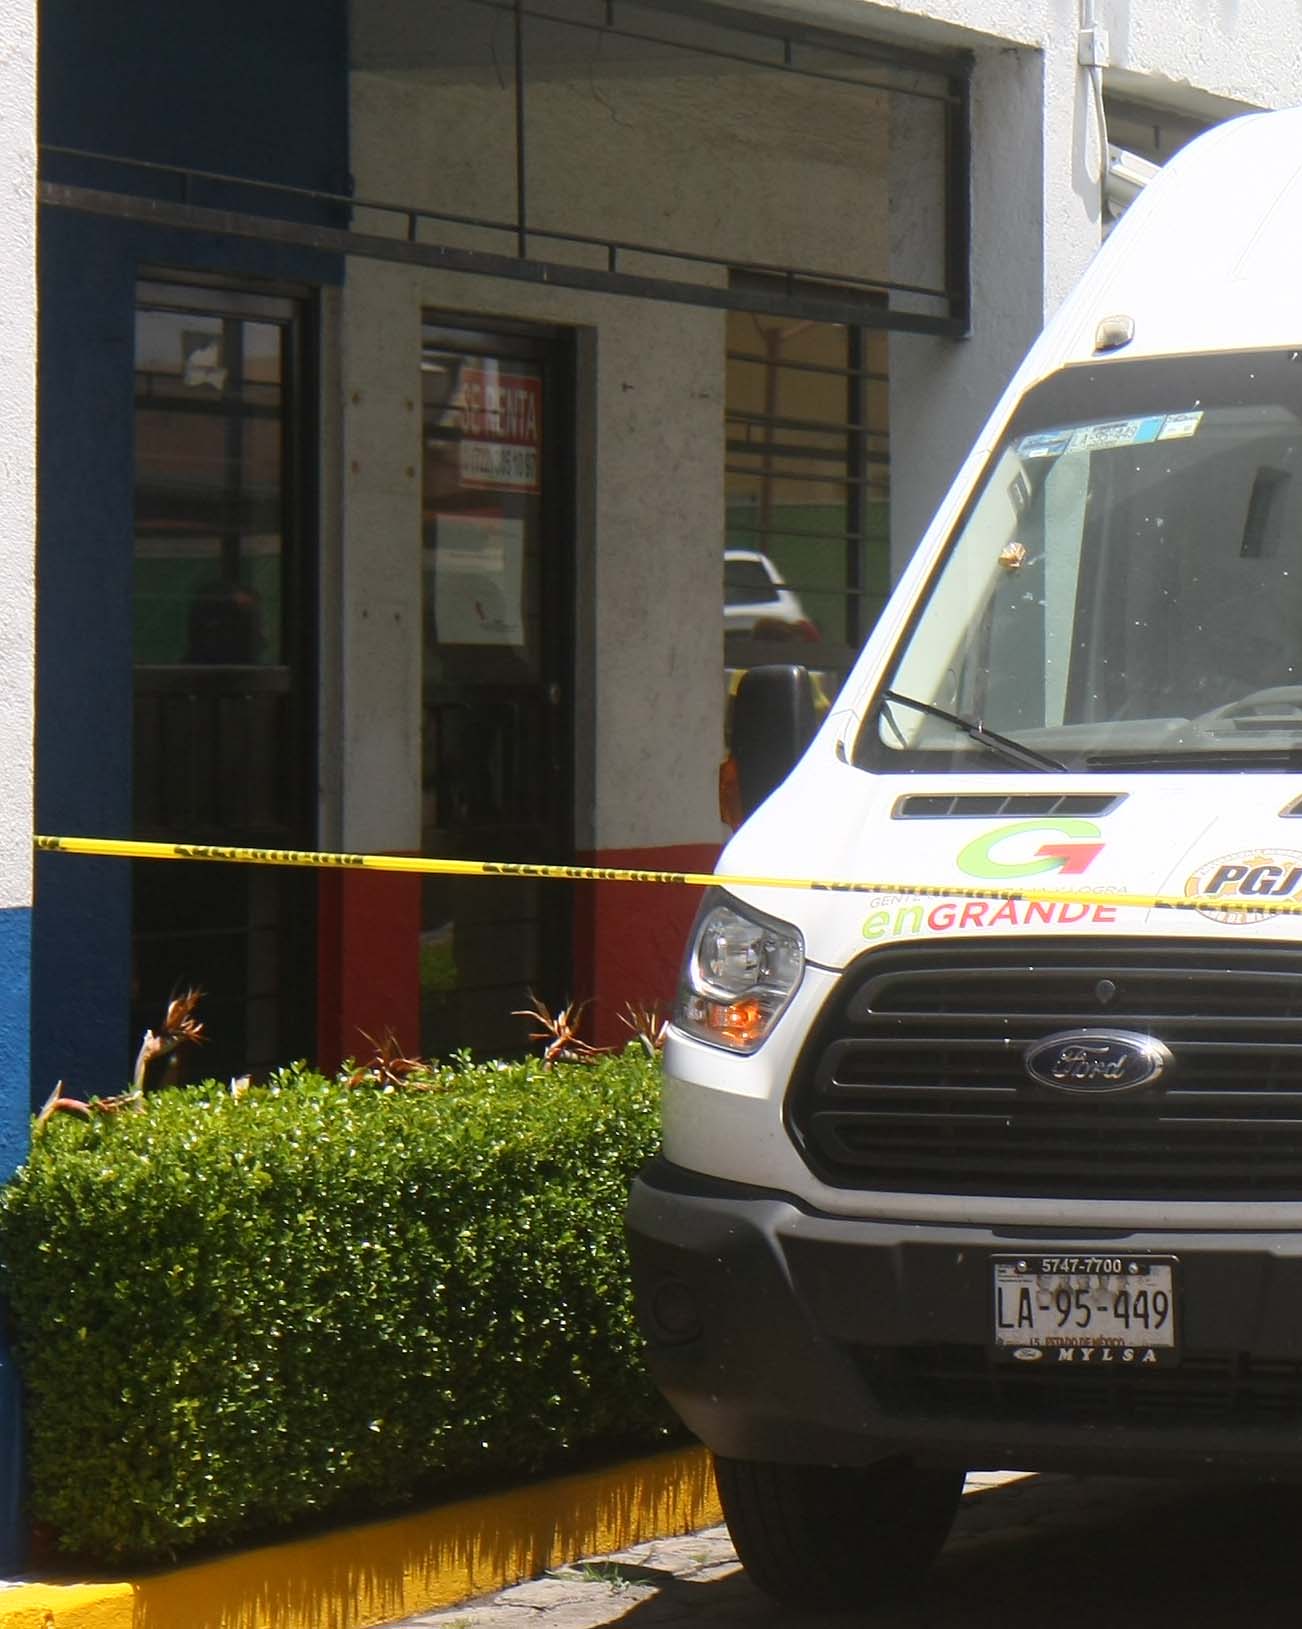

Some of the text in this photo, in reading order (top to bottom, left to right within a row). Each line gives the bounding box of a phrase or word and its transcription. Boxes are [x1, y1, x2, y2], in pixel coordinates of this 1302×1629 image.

[861, 899, 1118, 941] enGRANDE
[1051, 1044, 1128, 1079] Ford
[1041, 1258, 1122, 1273] 5747-7700
[997, 1287, 1169, 1329] LA-95-449
[1058, 1348, 1157, 1362] MYLSA
